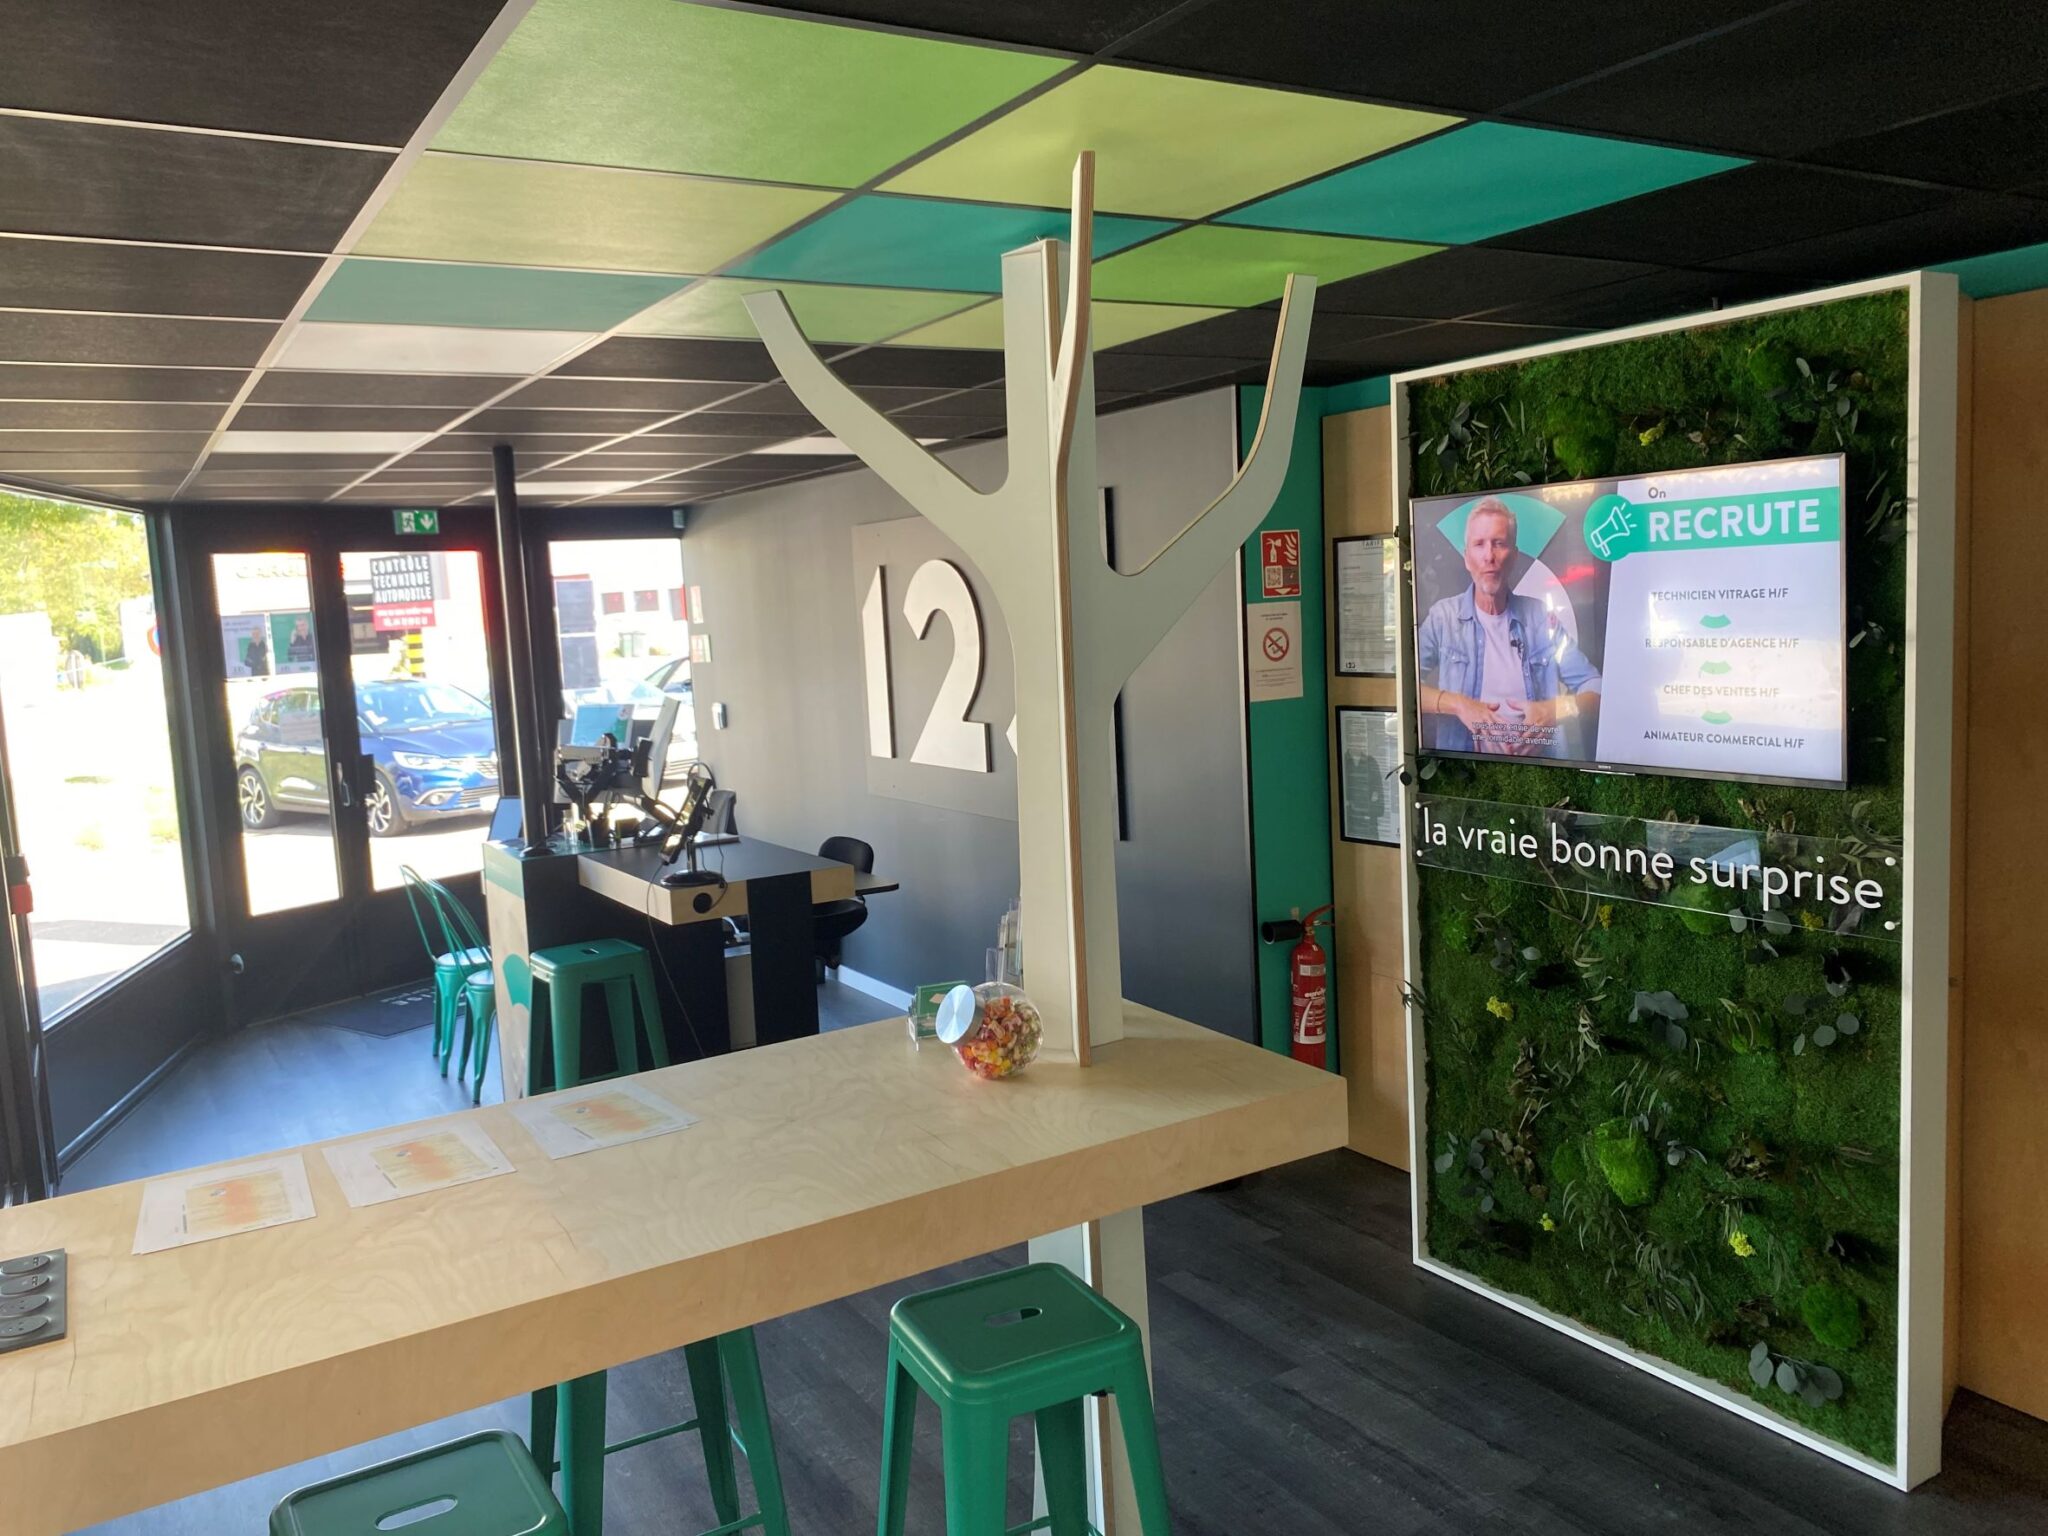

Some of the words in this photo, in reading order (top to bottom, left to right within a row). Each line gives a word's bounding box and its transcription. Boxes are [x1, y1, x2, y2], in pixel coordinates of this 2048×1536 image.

[1648, 487, 1666, 499] On
[1649, 498, 1820, 543] RECRUTE
[372, 555, 429, 575] CONTRÔLE
[373, 571, 430, 588] TECHNIQUE
[375, 586, 432, 603] AUTOMOBILE
[1651, 589, 1716, 601] TECHNICIEN
[1718, 588, 1766, 600] VITRAGE
[1768, 587, 1789, 599] H/F
[1720, 638, 1776, 649] D'AGENCE
[1779, 638, 1800, 649] H/F
[862, 557, 1018, 773] 12
[1663, 684, 1691, 696] CHEF
[1693, 685, 1713, 697] DES
[1715, 686, 1758, 698] VENTES
[1759, 687, 1780, 698] H/F
[1530, 725, 1539, 733] de
[1541, 726, 1559, 734] vivre
[1643, 730, 1704, 743] ANIMATEUR
[1706, 733, 1781, 748] COMMERCIAL
[1784, 738, 1805, 749] H/F
[1423, 807, 1447, 846] la
[1457, 818, 1538, 859] vraie
[1551, 822, 1674, 880] bonne
[1690, 855, 1884, 911] surprise
